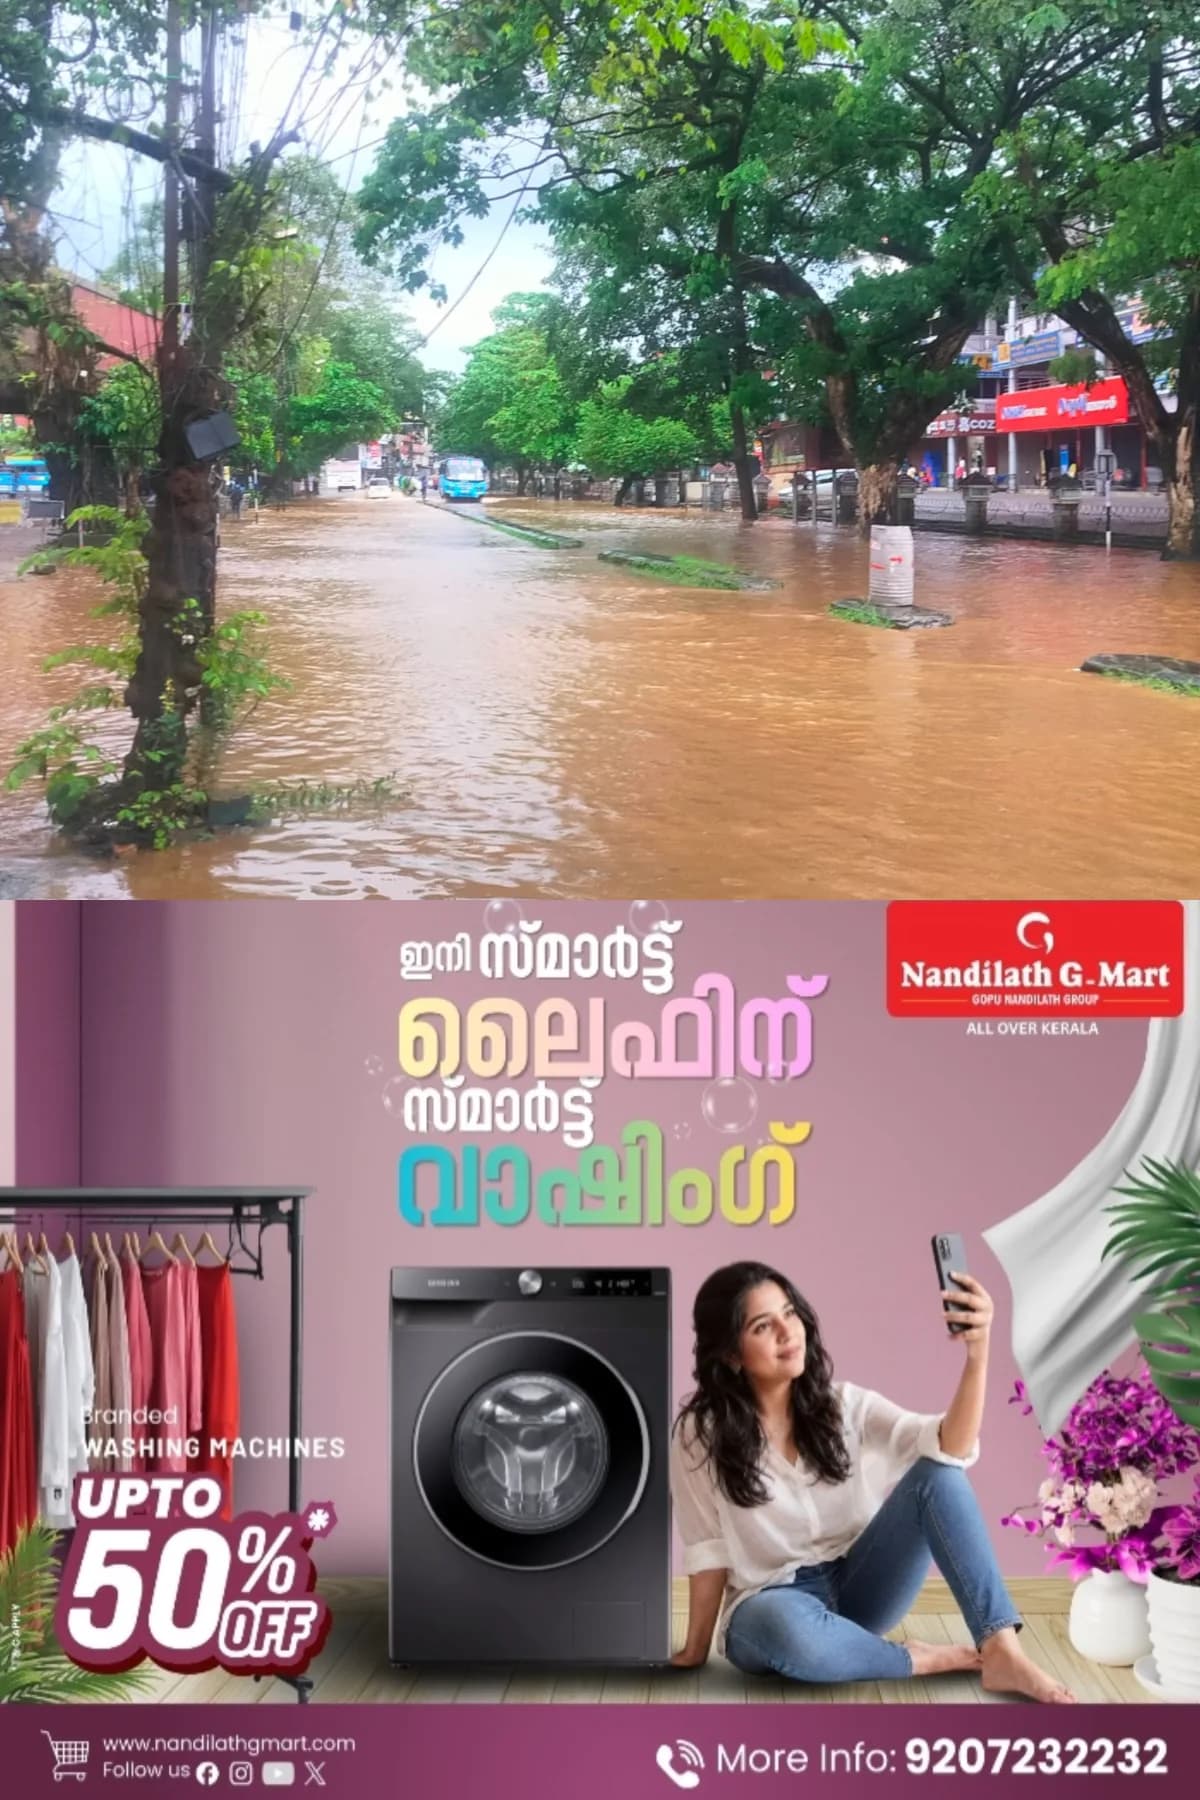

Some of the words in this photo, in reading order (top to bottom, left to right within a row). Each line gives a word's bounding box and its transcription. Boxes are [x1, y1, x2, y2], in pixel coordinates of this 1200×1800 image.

[400, 932, 472, 980] ഇനി
[479, 919, 683, 994] സ്മാർട്ട്
[901, 960, 1052, 987] Nandilath
[971, 994, 1001, 1005] GOPU
[1004, 994, 1061, 1005] NANDILATH
[1063, 994, 1099, 1005] GROUP
[399, 972, 829, 1078] ലൈഫിന്
[966, 1022, 994, 1035] ALL
[997, 1022, 1037, 1035] OVER
[1041, 1022, 1099, 1035] KERALA
[398, 1120, 812, 1227] വാഷിംഗ്
[81, 1405, 178, 1425] Branded
[82, 1437, 200, 1458] WASHING
[209, 1437, 345, 1458] MACHINES
[77, 1478, 222, 1519] UPTO
[218, 1600, 318, 1658] OFF
[103, 1735, 356, 1756] www.nandilathgmart.com
[717, 1743, 809, 1774] More
[821, 1741, 897, 1774] Info:
[905, 1737, 1168, 1774] 9207232232
[103, 1762, 163, 1778] Follow
[168, 1764, 190, 1778] us
